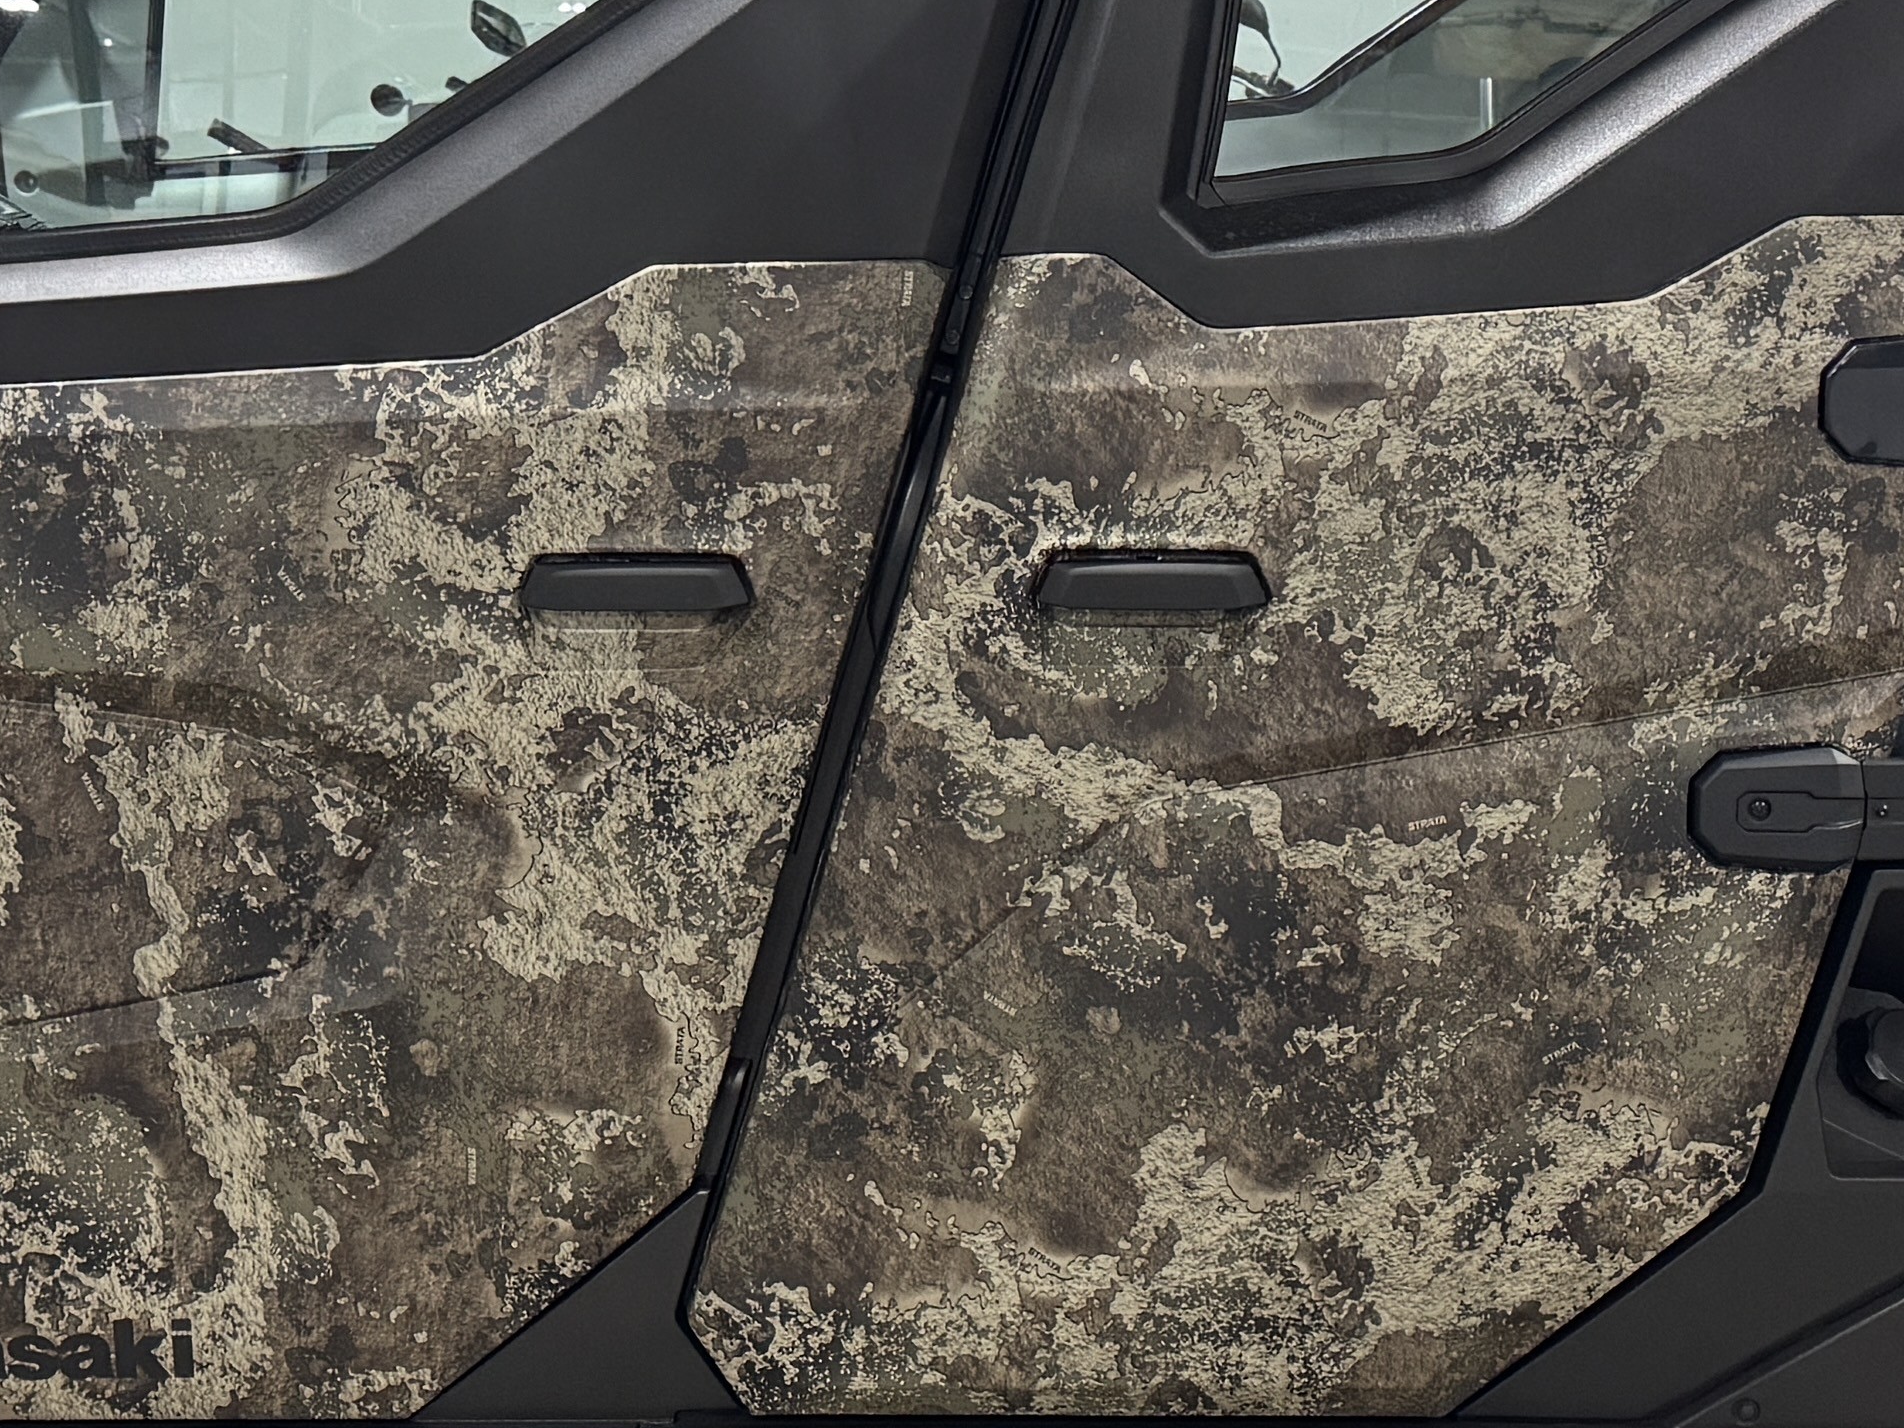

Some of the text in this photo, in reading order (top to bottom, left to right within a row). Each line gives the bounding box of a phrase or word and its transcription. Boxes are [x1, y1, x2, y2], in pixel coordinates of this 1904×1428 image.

[1294, 410, 1327, 433] STRATA
[1408, 815, 1447, 832] STRATA
[1542, 1041, 1582, 1065] STRATA
[1028, 1247, 1061, 1273] STRATA
